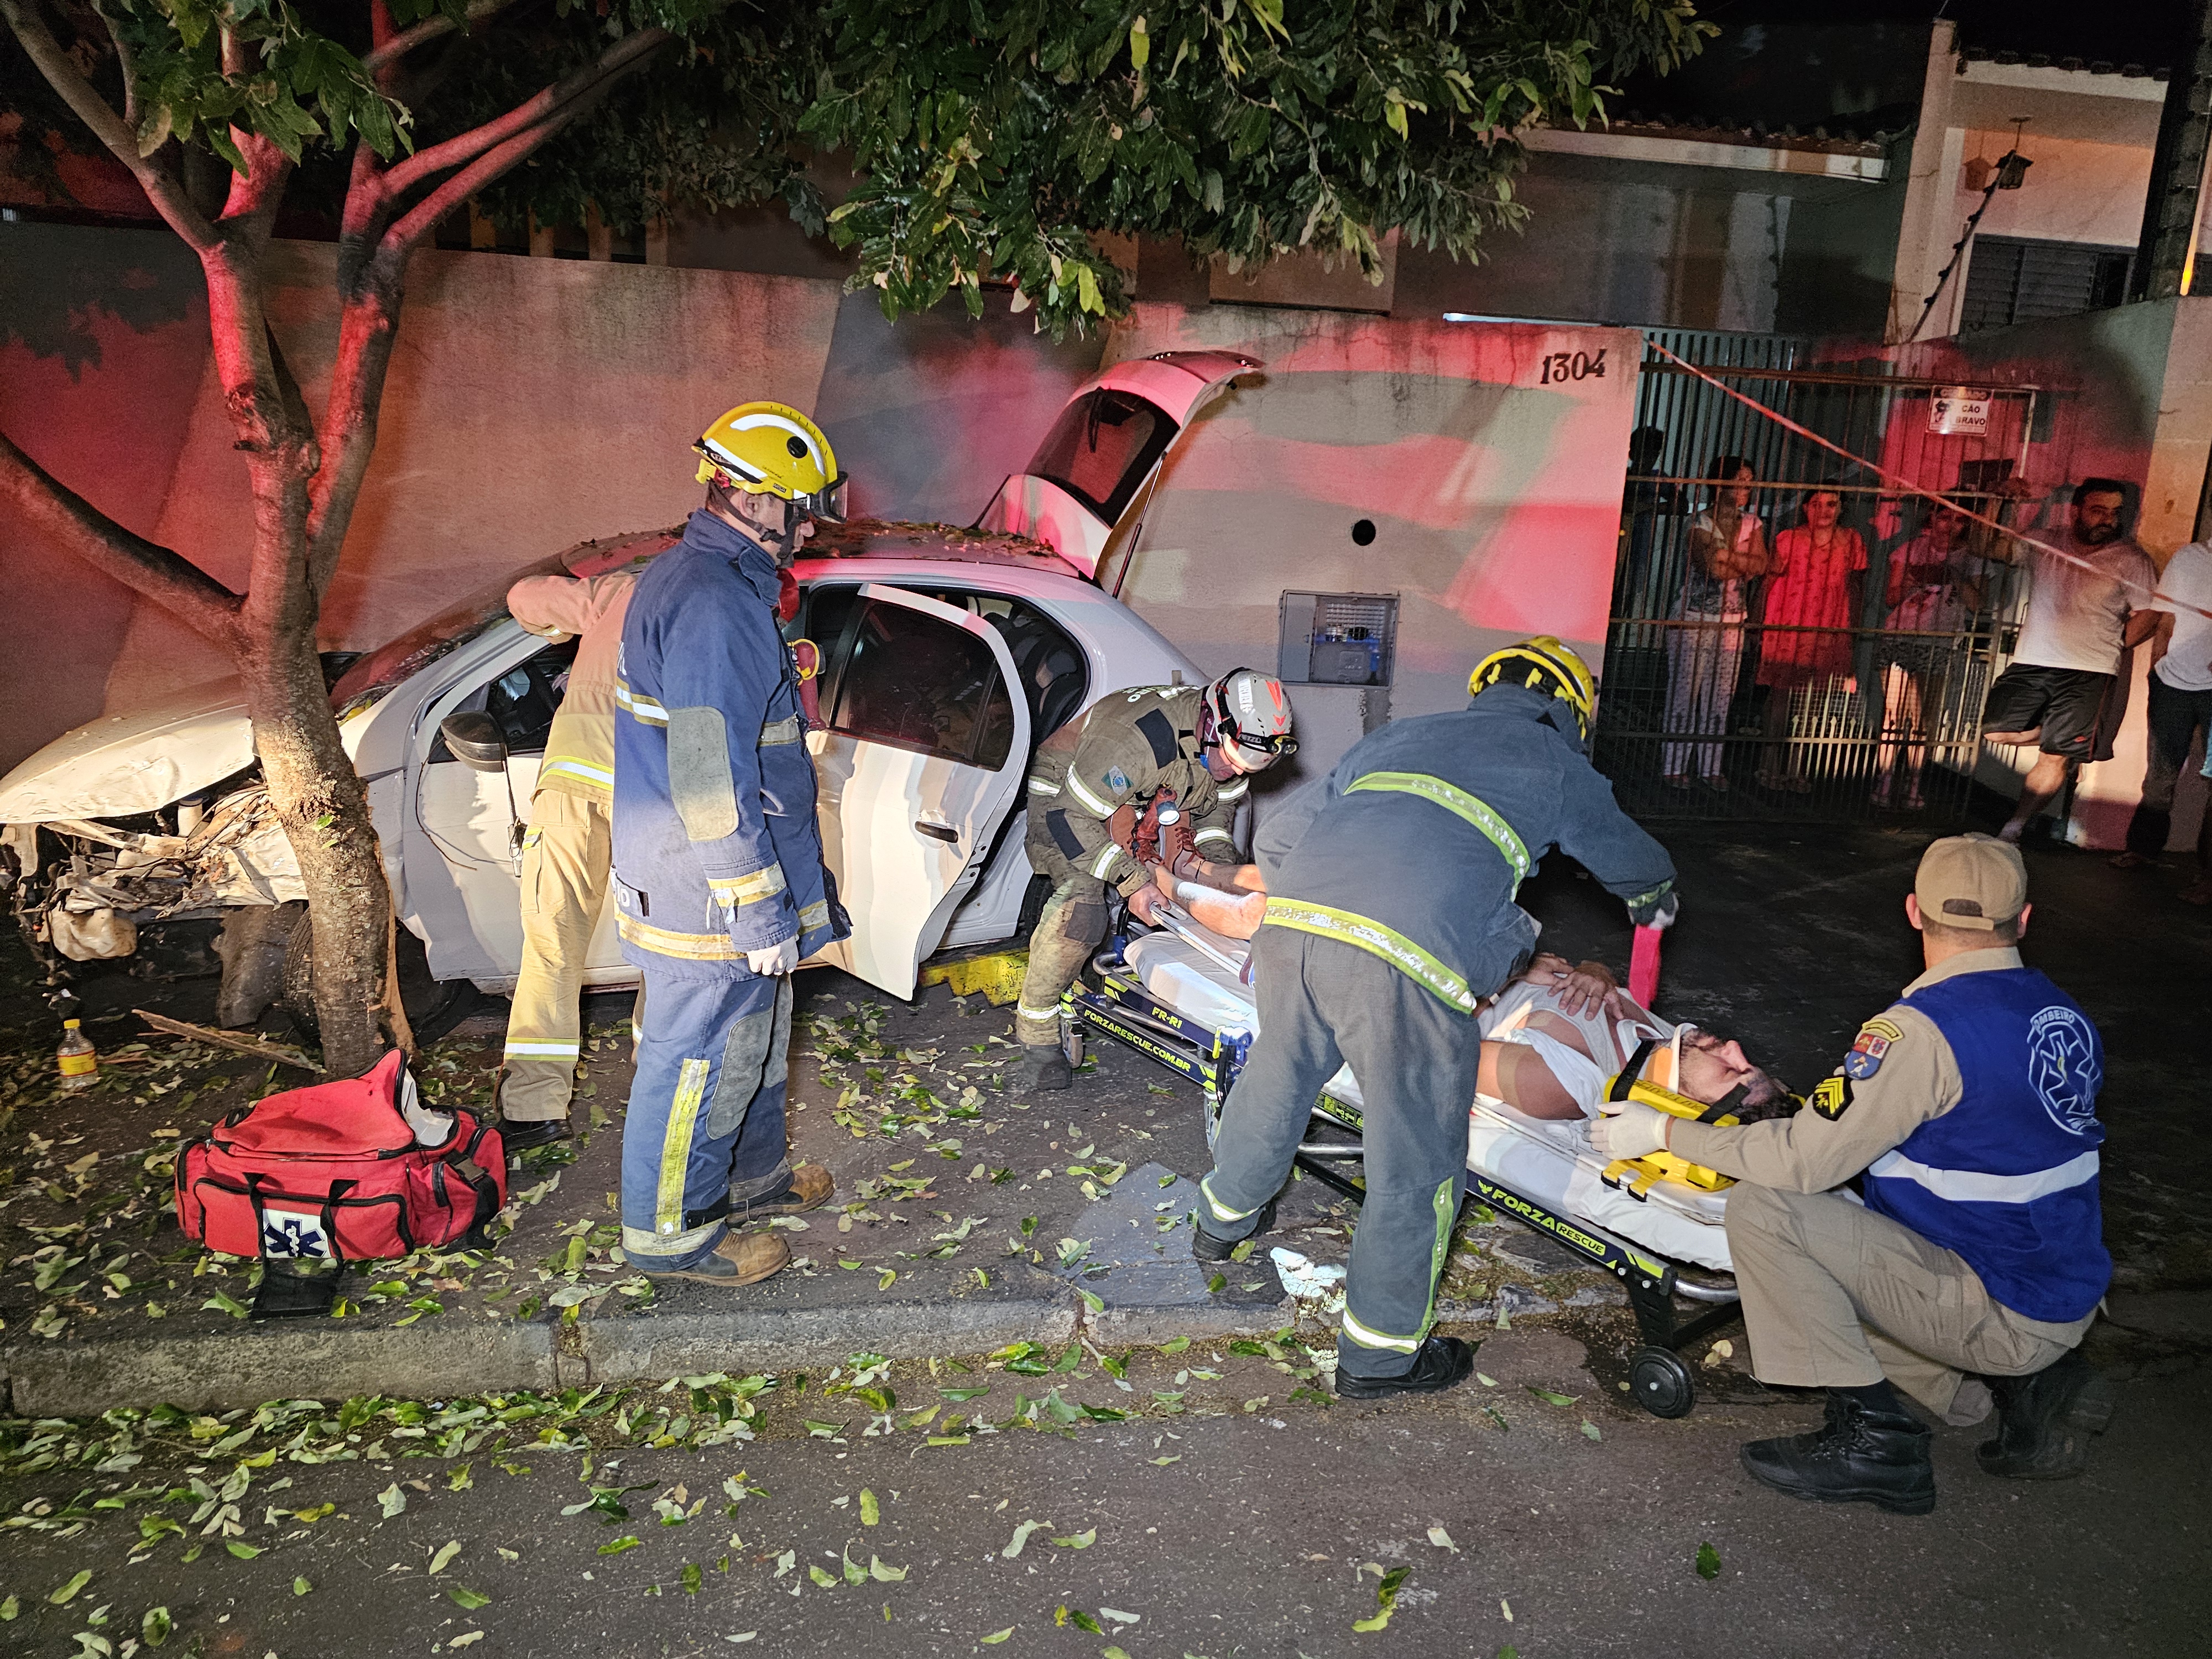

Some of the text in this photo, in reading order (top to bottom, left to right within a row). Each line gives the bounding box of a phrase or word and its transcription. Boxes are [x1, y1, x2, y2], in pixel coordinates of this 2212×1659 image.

[1540, 349, 1607, 384] 1304
[1955, 416, 1985, 425] BRAVO
[2033, 1009, 2075, 1031] OMBEIRO
[1084, 1009, 1191, 1072] FORZARESCUE.COM.BR
[1492, 1189, 1603, 1254] FORZA RESCUE
